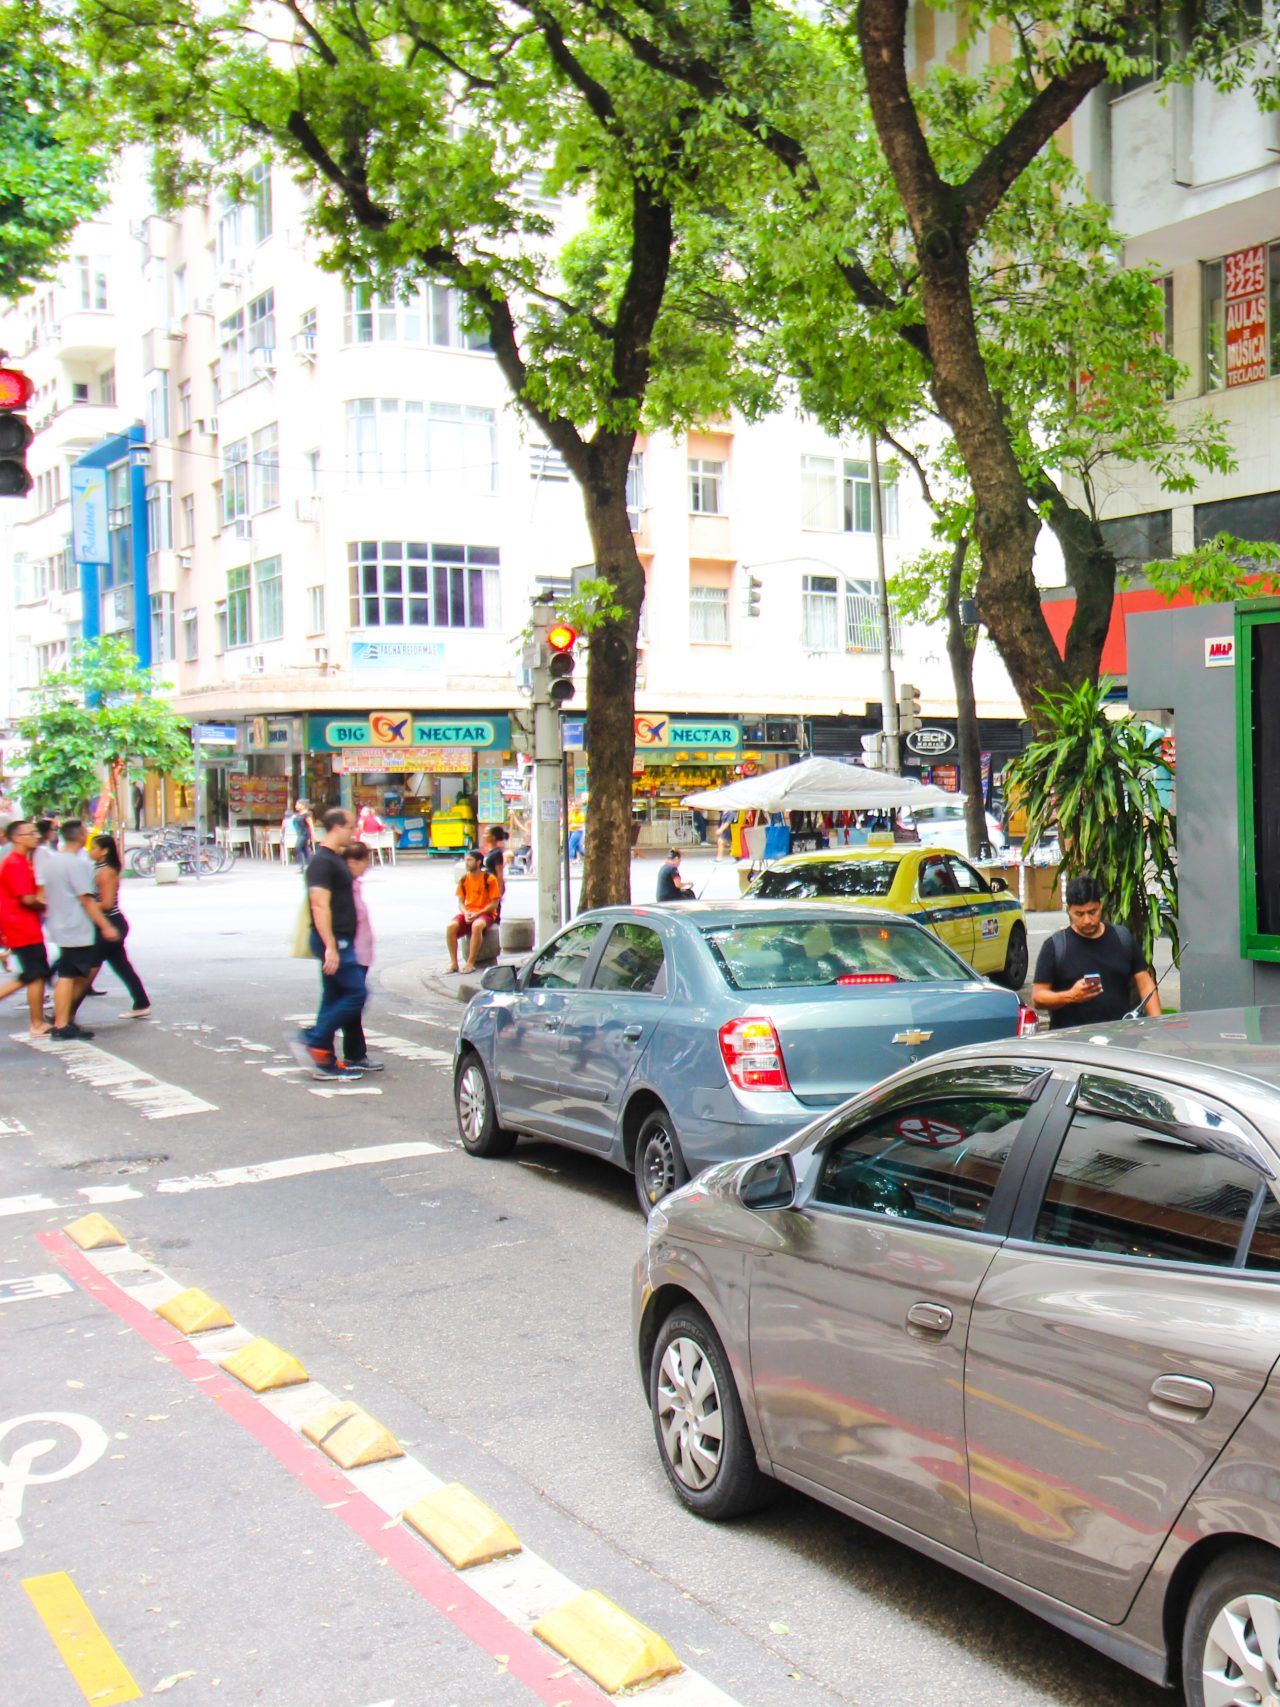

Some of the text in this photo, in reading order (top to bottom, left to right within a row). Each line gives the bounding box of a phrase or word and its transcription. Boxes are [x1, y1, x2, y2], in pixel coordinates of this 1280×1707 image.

[1226, 247, 1264, 276] 3344
[1226, 268, 1264, 297] 2225
[1227, 297, 1265, 331] AULAS
[1242, 329, 1250, 339] DE
[1227, 335, 1265, 369] MÚSICA
[1228, 366, 1265, 385] TECLADO
[1209, 642, 1233, 657] AM&P
[337, 727, 486, 741] BIG NECTAR
[672, 729, 732, 743] NECTAR
[916, 732, 947, 742] TECH
